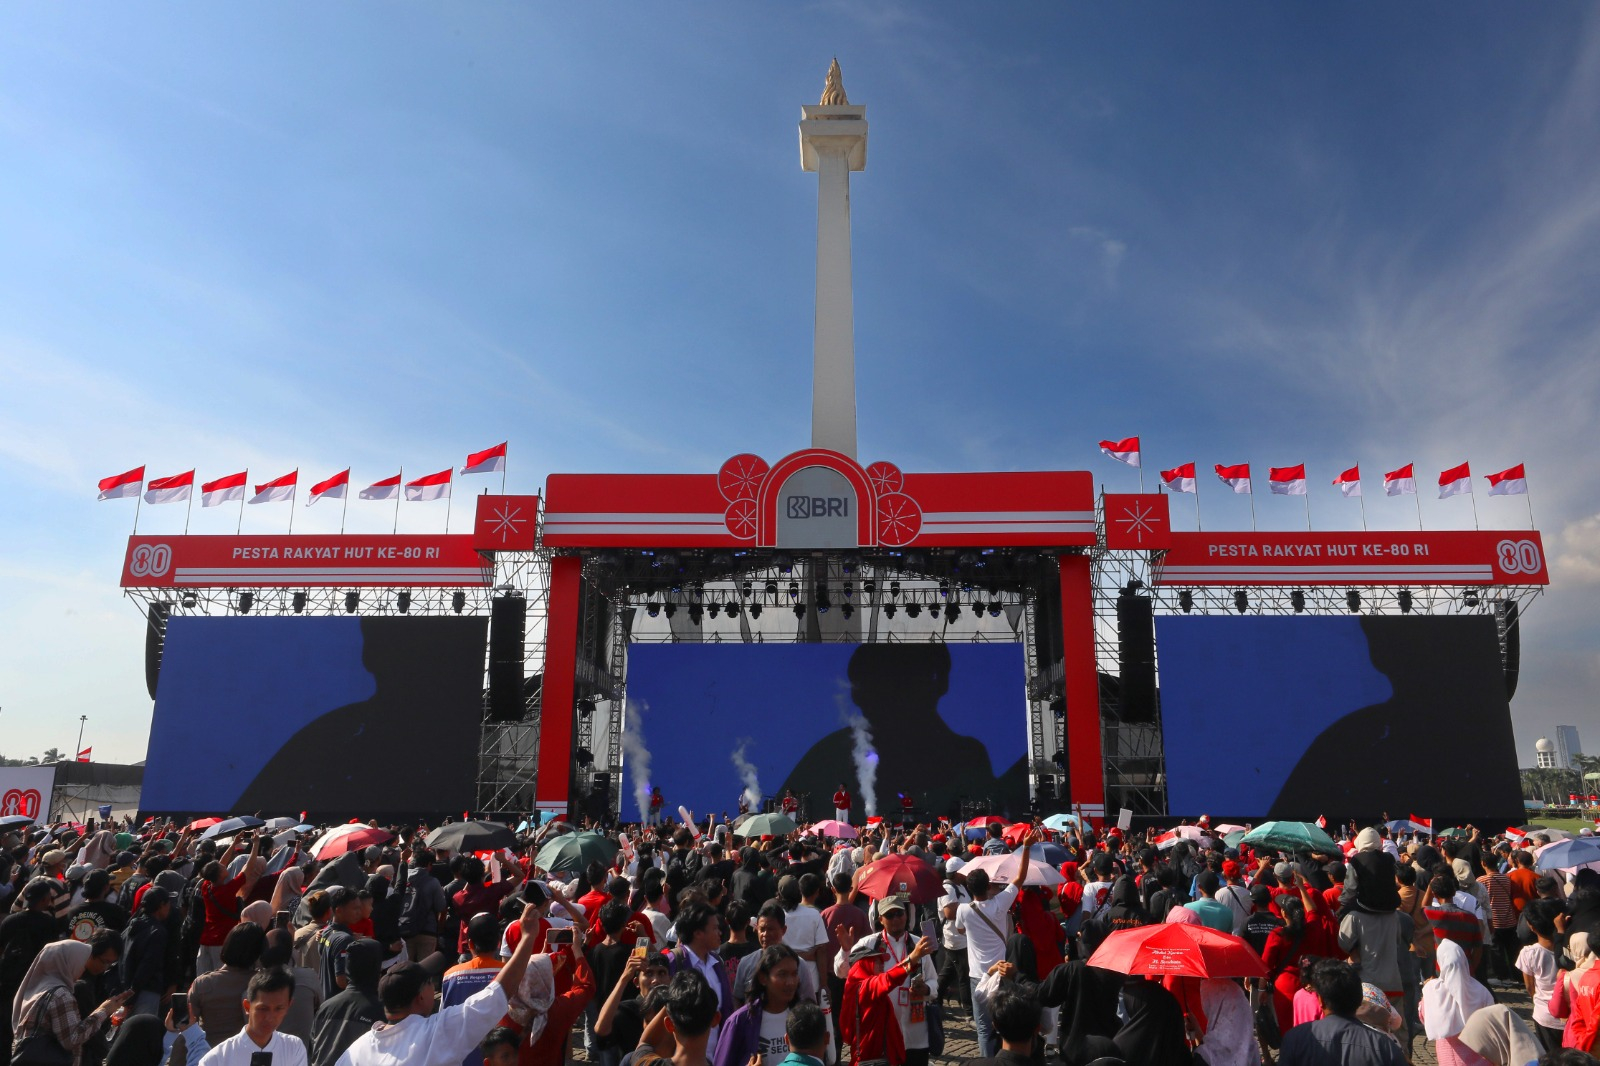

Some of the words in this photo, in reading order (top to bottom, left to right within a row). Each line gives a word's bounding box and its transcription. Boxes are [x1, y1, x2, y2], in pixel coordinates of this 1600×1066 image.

[812, 498, 848, 517] BRI
[232, 547, 279, 559] PESTA
[283, 547, 341, 559] RAKYAT
[344, 547, 374, 558] HUT
[377, 547, 422, 558] KE-80
[425, 547, 440, 558] RI
[1209, 544, 1258, 557] PESTA
[1262, 544, 1322, 557] RAKYAT
[1327, 544, 1358, 556] HUT
[1362, 544, 1410, 556] KE-80
[1414, 543, 1429, 556] RI
[1497, 539, 1541, 575] 80
[130, 544, 172, 577] 80
[1, 788, 41, 820] 80
[770, 1037, 786, 1046] THI
[771, 1045, 789, 1054] SEC
